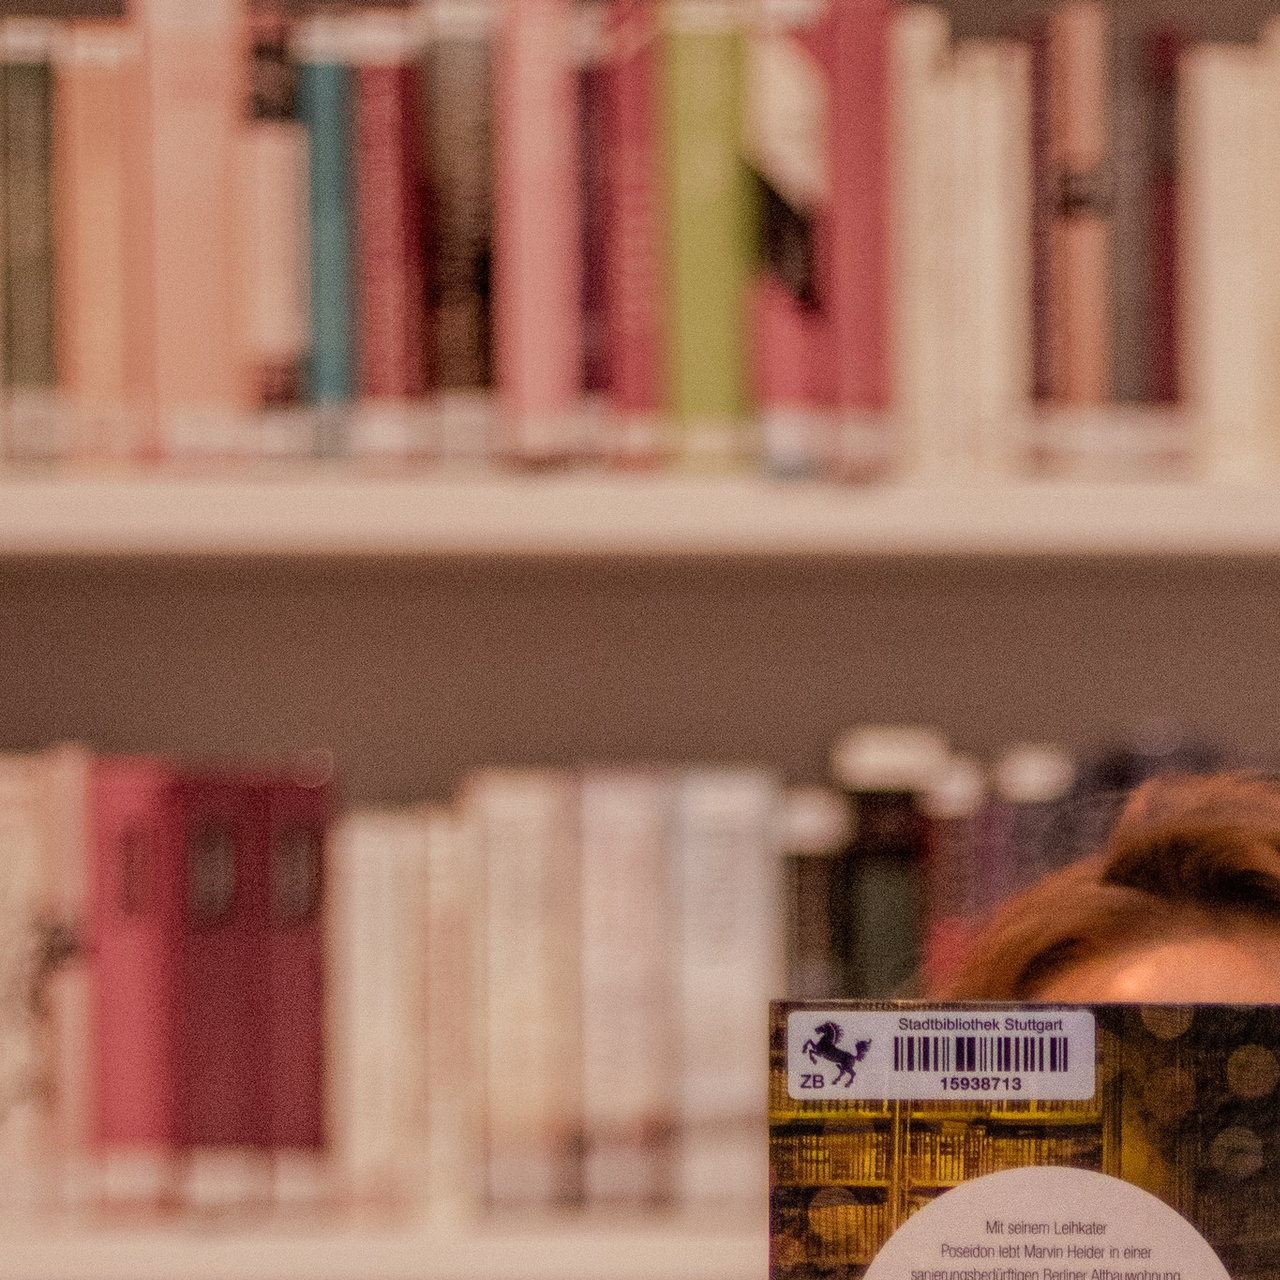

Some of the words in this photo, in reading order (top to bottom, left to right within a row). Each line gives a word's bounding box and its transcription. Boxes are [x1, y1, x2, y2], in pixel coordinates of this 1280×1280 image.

[899, 1018, 999, 1031] Stadtbibliothek
[1004, 1018, 1063, 1034] Stuttgart
[800, 1074, 825, 1089] ZB
[940, 1077, 1022, 1091] 15938713
[986, 1219, 1004, 1235] Mit
[1008, 1220, 1049, 1235] seinem
[1054, 1220, 1107, 1236] Leihkater
[941, 1242, 995, 1259] Poseidon
[999, 1244, 1020, 1259] lebt
[1024, 1244, 1063, 1259] Marvin
[1067, 1245, 1105, 1259] Heider
[1109, 1245, 1119, 1259] in
[1123, 1246, 1152, 1260] einer
